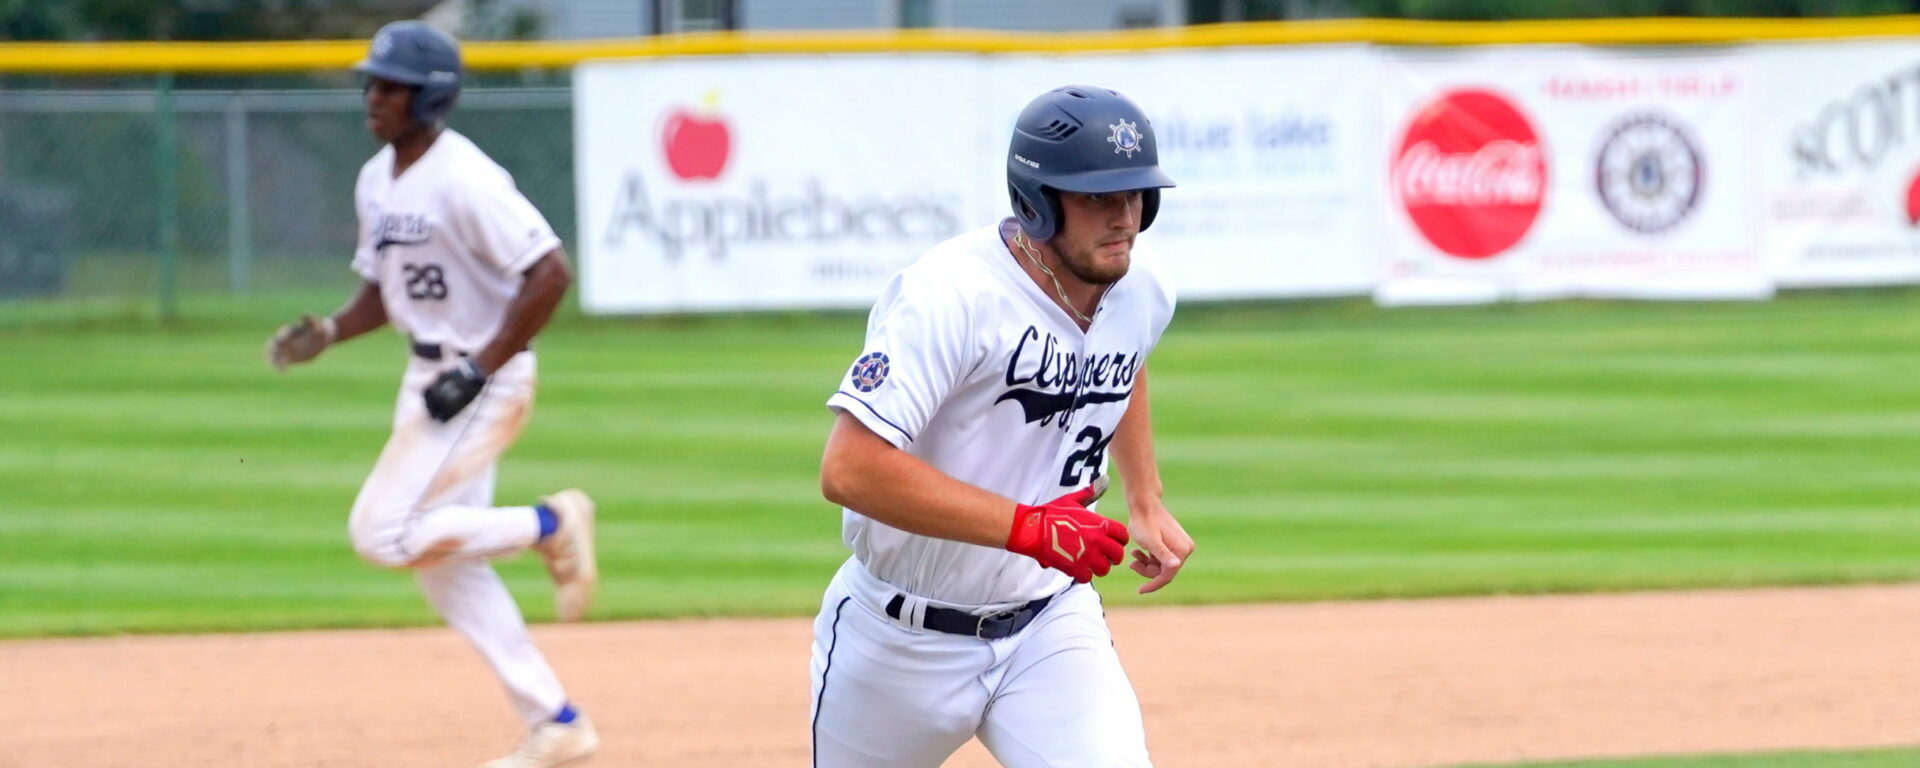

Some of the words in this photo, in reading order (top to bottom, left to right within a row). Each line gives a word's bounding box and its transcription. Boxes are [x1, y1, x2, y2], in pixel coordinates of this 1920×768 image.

[402, 262, 448, 300] 28
[1005, 325, 1138, 428] Clippers
[1059, 425, 1114, 487] 24
